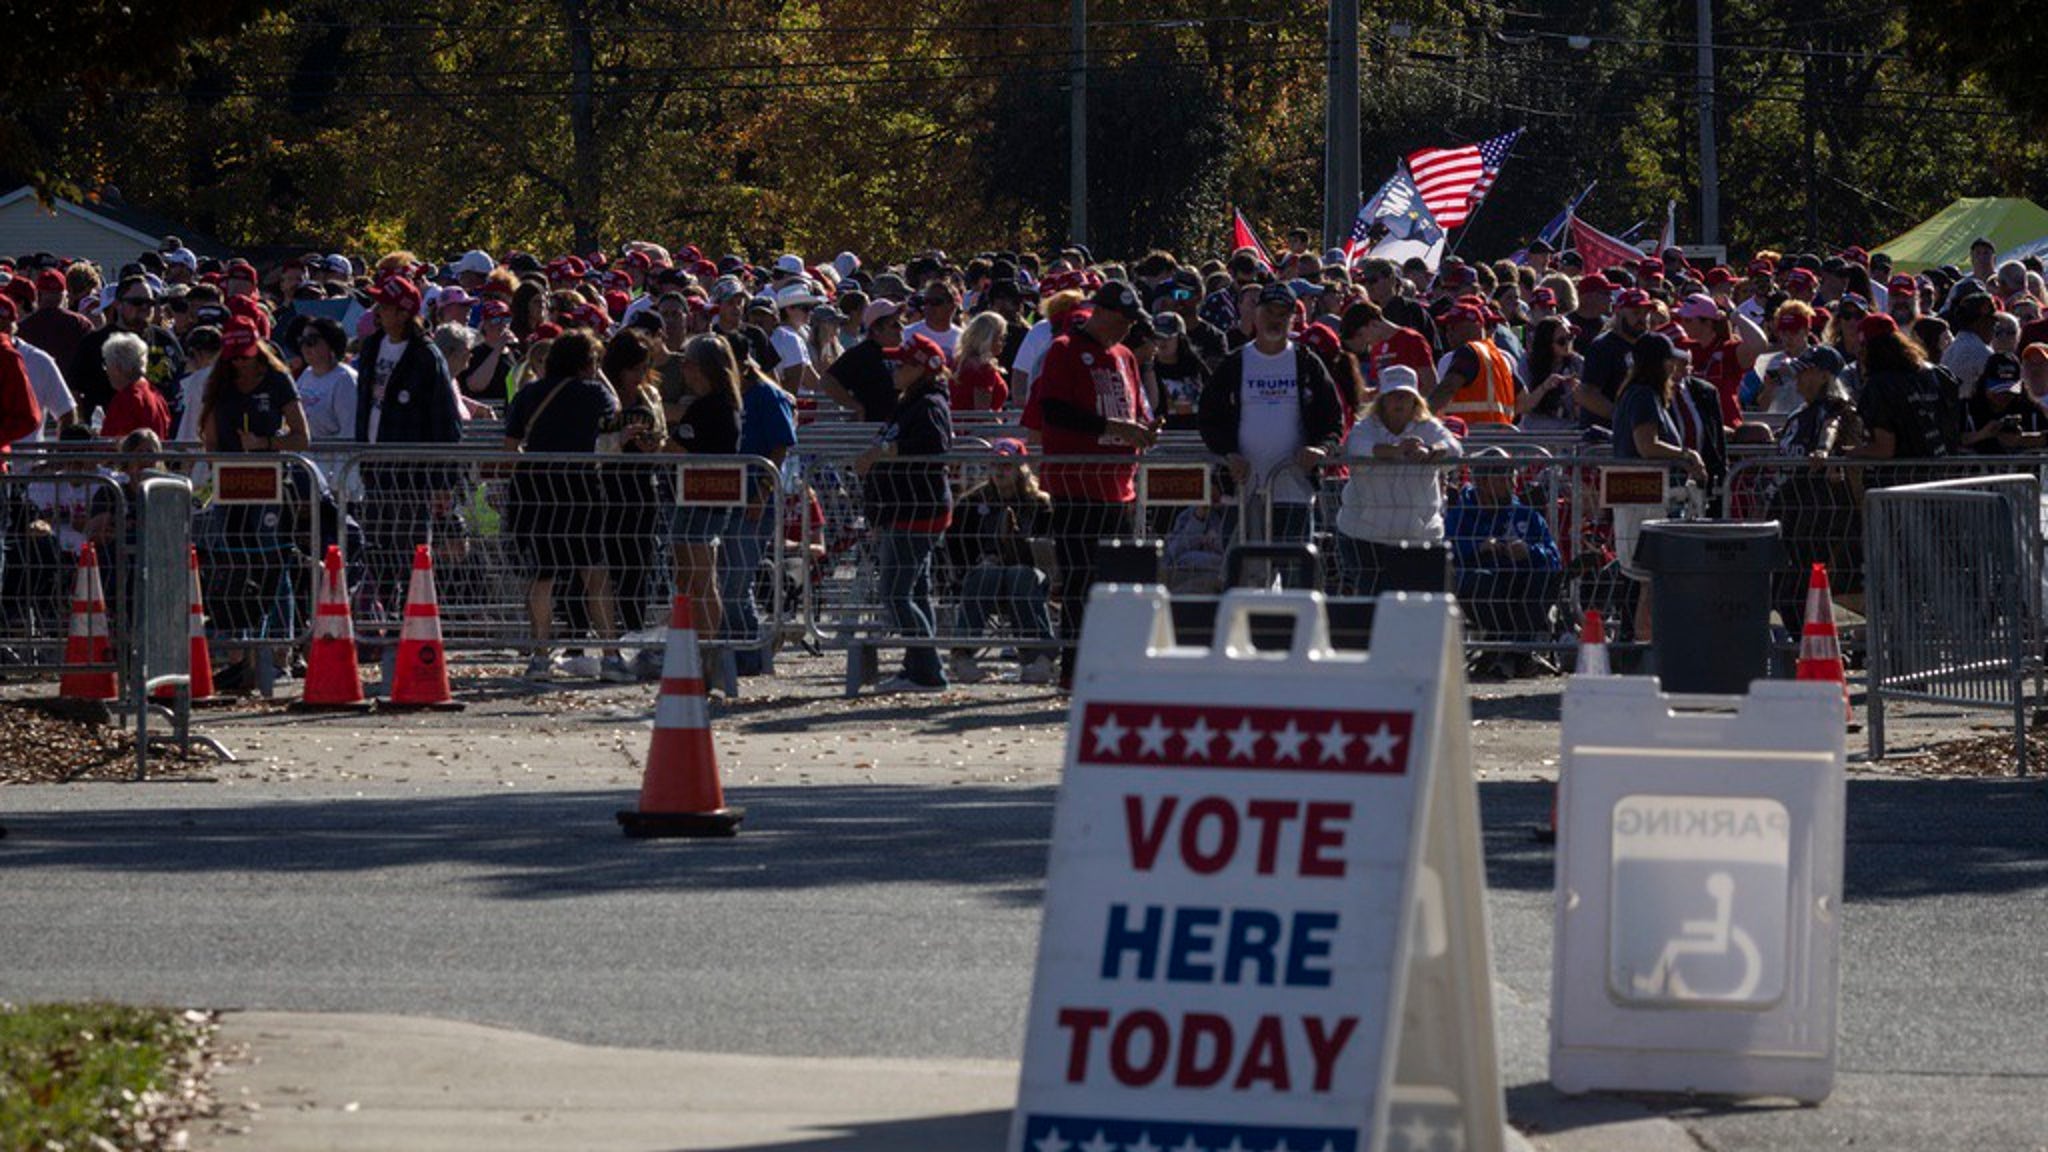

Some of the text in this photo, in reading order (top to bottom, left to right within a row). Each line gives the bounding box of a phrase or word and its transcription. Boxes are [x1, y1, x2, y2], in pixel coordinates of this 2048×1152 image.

[1124, 795, 1353, 878] VOTE
[1100, 904, 1340, 987] HERE
[1057, 1008, 1359, 1092] TODAY
